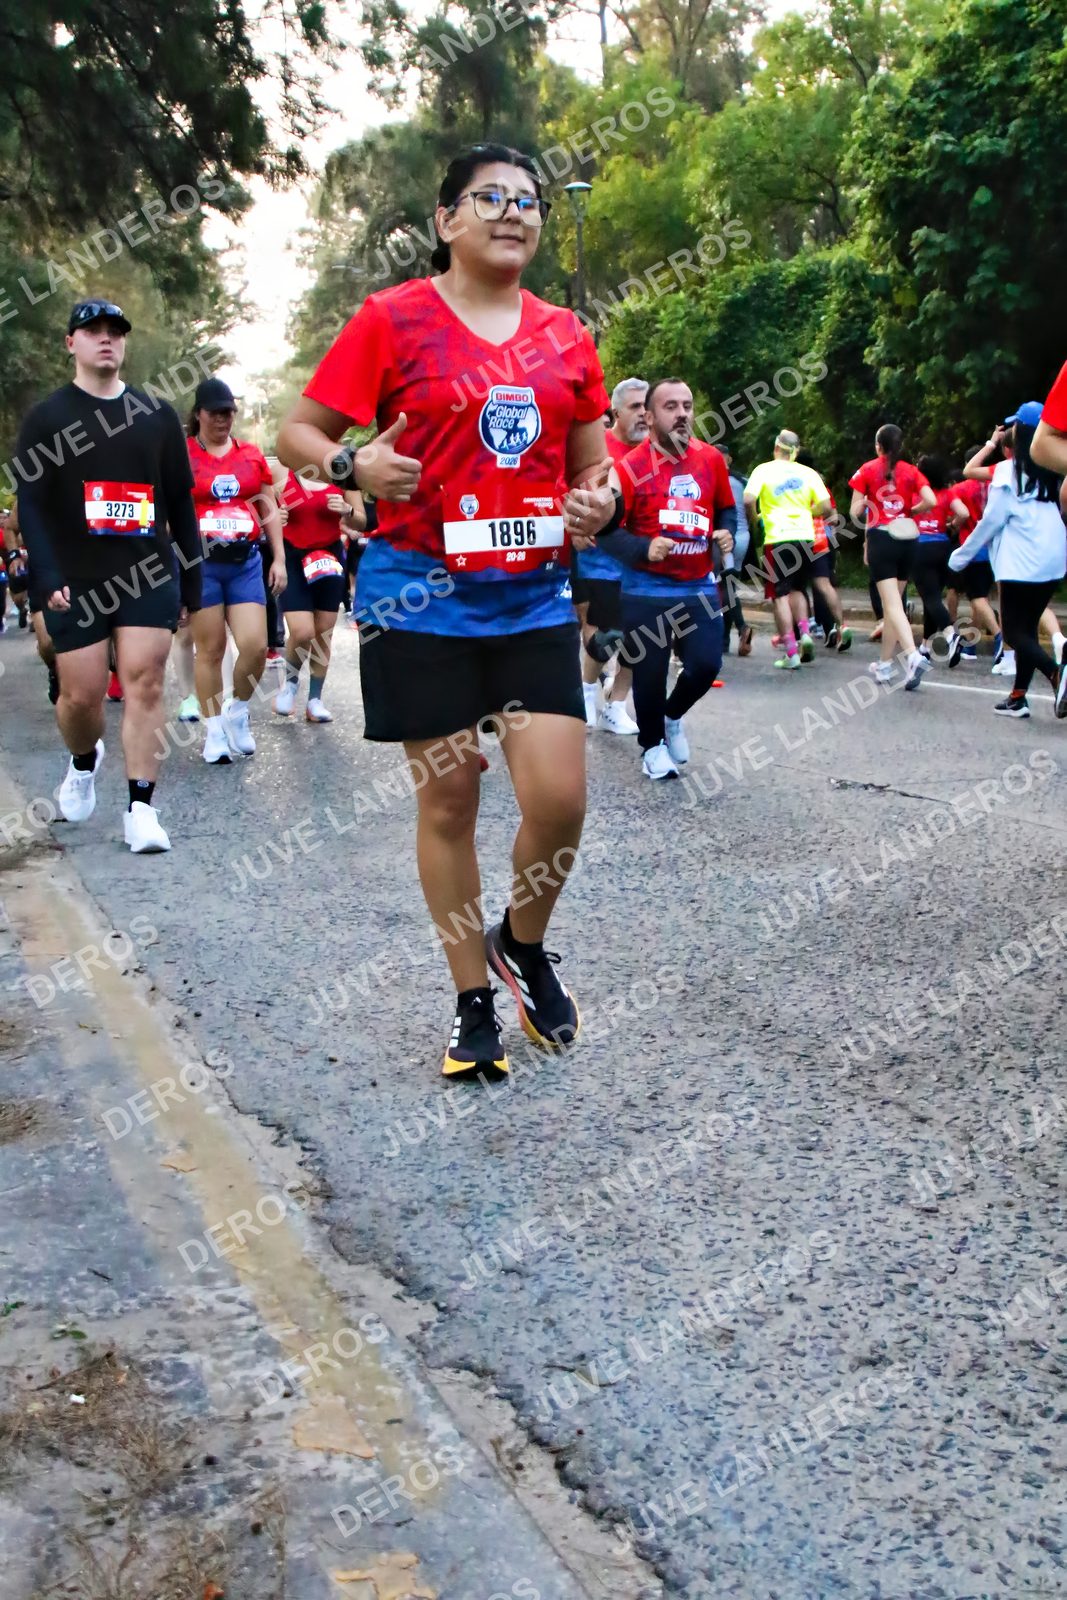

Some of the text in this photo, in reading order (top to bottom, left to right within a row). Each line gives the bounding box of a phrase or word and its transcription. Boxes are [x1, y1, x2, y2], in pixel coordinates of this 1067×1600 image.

[495, 393, 529, 402] BIMBO
[495, 405, 528, 419] Global
[488, 416, 515, 429] Race
[499, 456, 518, 466] 2026
[106, 502, 134, 518] 3273
[679, 512, 699, 526] 3119
[488, 519, 537, 547] 1896
